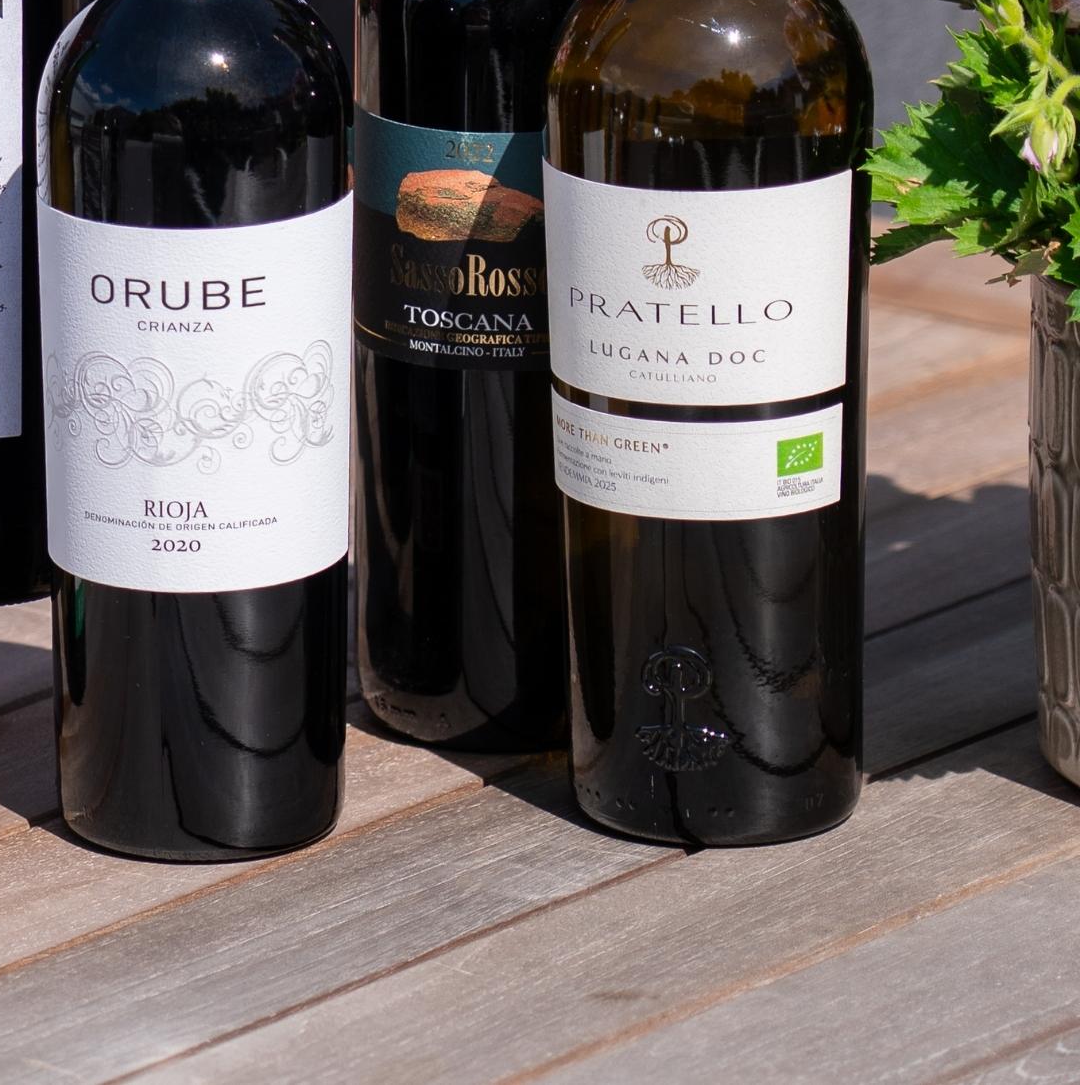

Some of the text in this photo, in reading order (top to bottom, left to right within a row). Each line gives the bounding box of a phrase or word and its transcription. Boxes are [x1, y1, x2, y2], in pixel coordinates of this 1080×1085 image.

[91, 274, 266, 311] ORUBE
[570, 286, 793, 326] PRATELLO
[137, 320, 214, 333] CRIANZA
[404, 305, 533, 331] TOSCANA
[409, 339, 526, 357] MONTALCINO ITALY
[590, 339, 766, 365] LUGANA DOC
[629, 370, 717, 383] CATULLIANO
[579, 428, 609, 446] THAN
[594, 479, 617, 492] 2025
[144, 499, 208, 522] RIOJA
[84, 510, 277, 531] DENOMINACIÓN DE ORIGEN CALIFICADA
[151, 539, 201, 553] 2020
